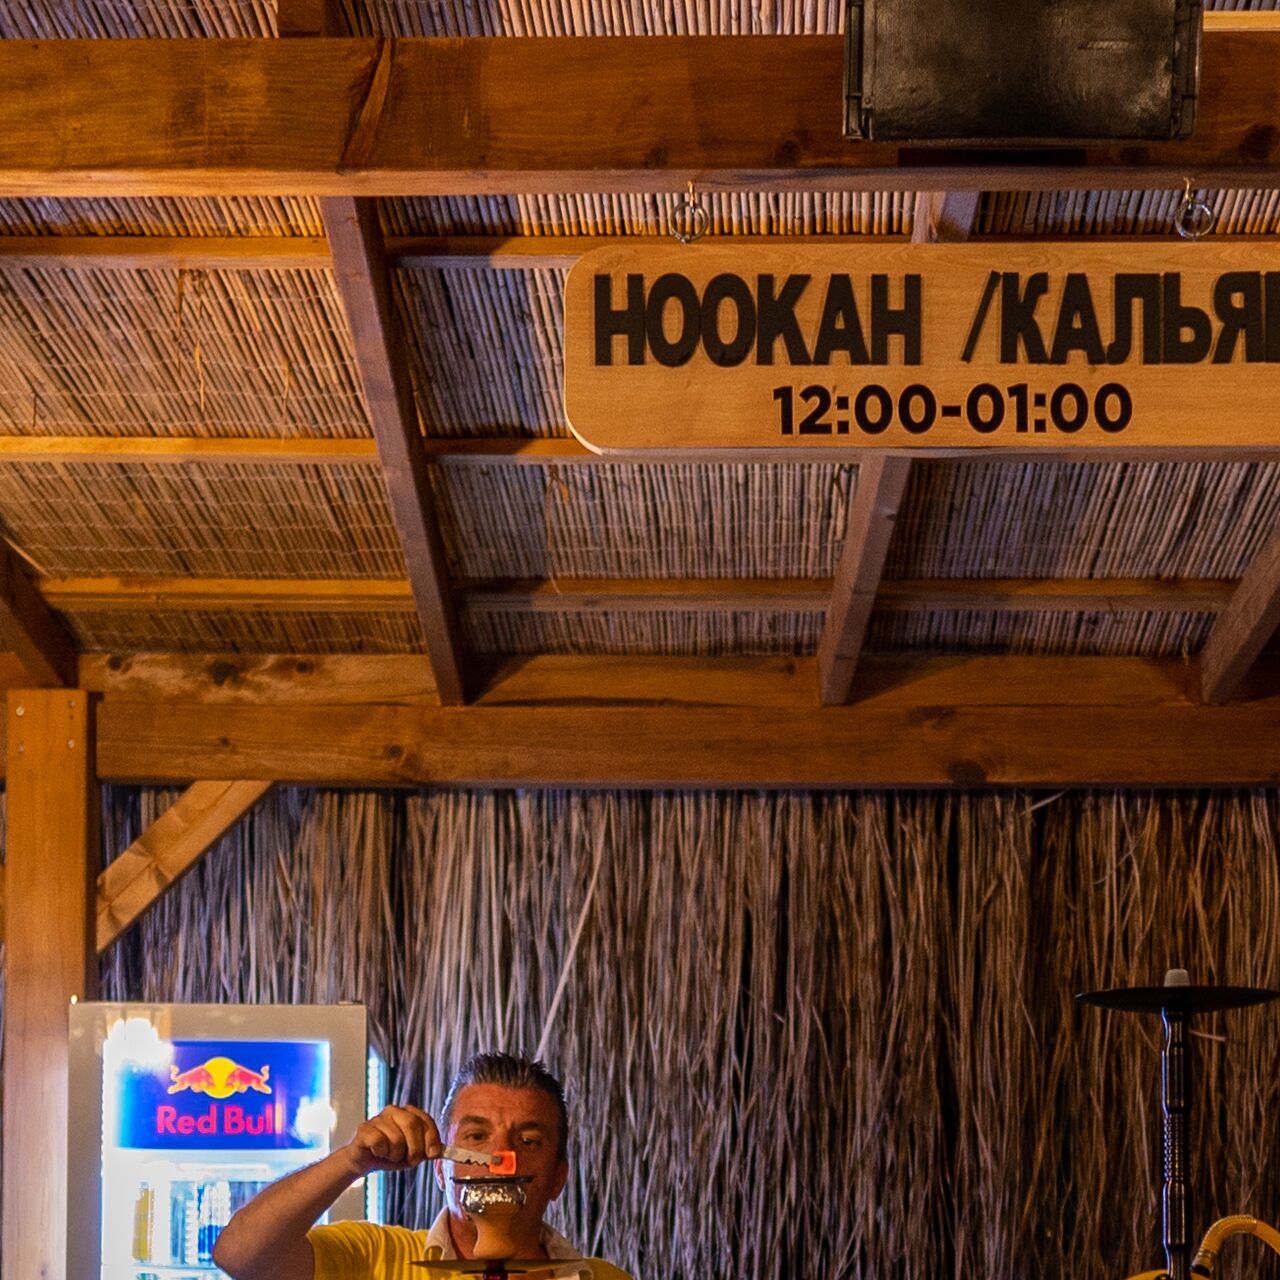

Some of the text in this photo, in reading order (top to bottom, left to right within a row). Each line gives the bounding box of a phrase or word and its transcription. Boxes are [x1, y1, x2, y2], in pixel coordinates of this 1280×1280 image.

[594, 273, 920, 367] HOOKAH
[772, 382, 1133, 435] 12:00-01:00
[157, 1104, 282, 1134] Red Bull
